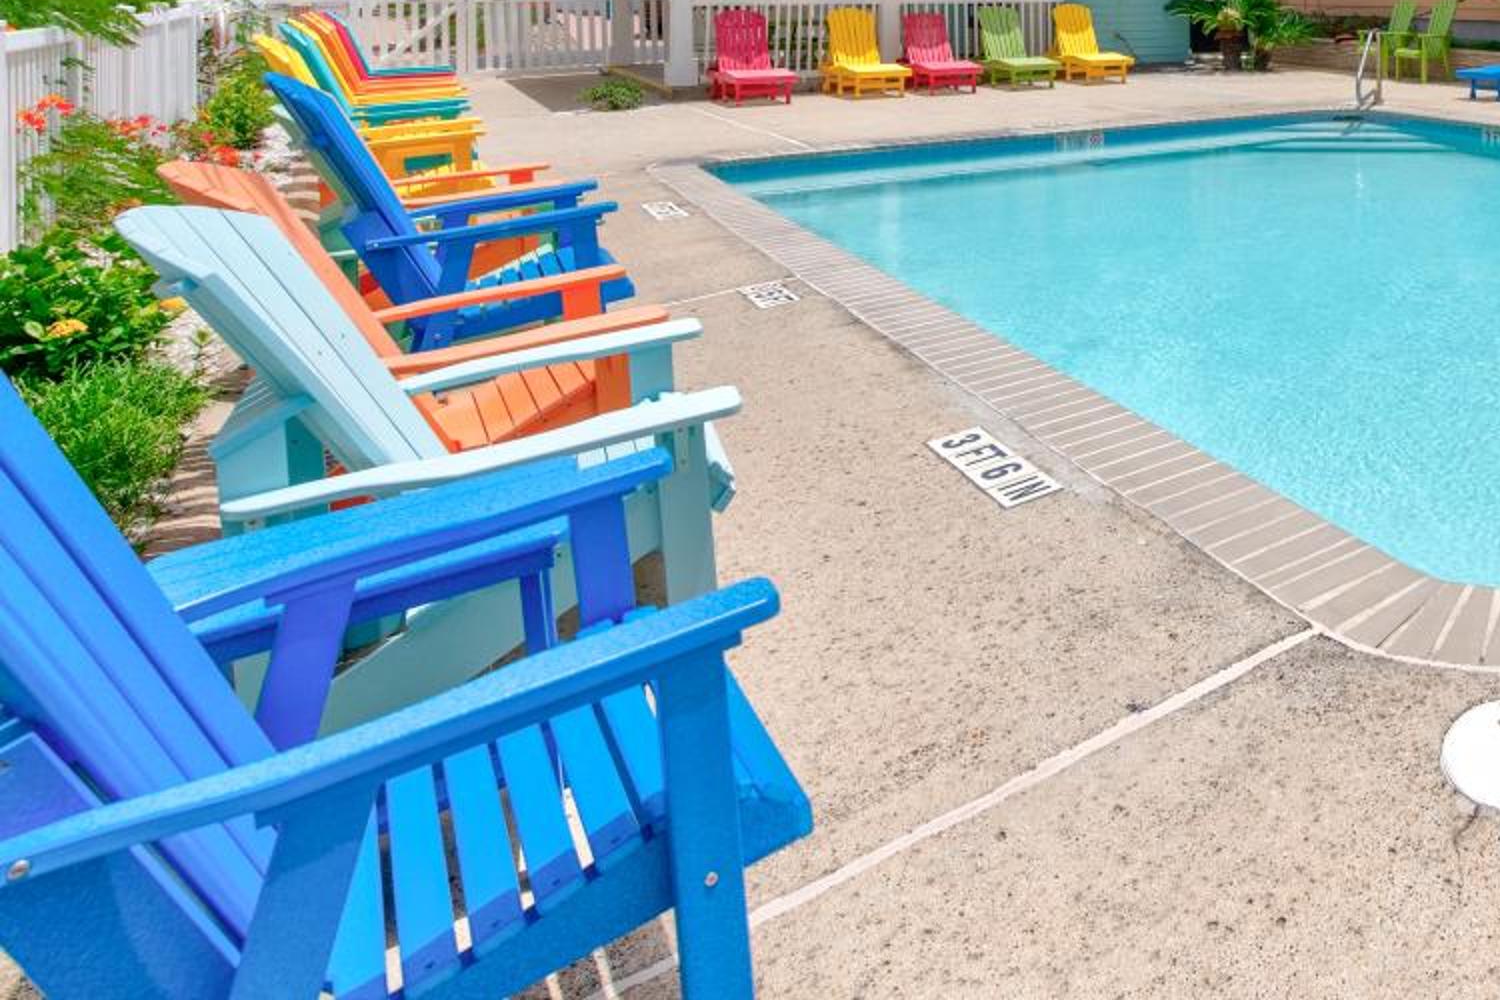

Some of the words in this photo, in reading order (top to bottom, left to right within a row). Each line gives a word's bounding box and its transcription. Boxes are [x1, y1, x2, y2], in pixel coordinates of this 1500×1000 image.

[941, 433, 982, 449] 3
[955, 443, 1008, 467] FT
[980, 462, 1023, 480] 6
[998, 475, 1052, 501] IN
